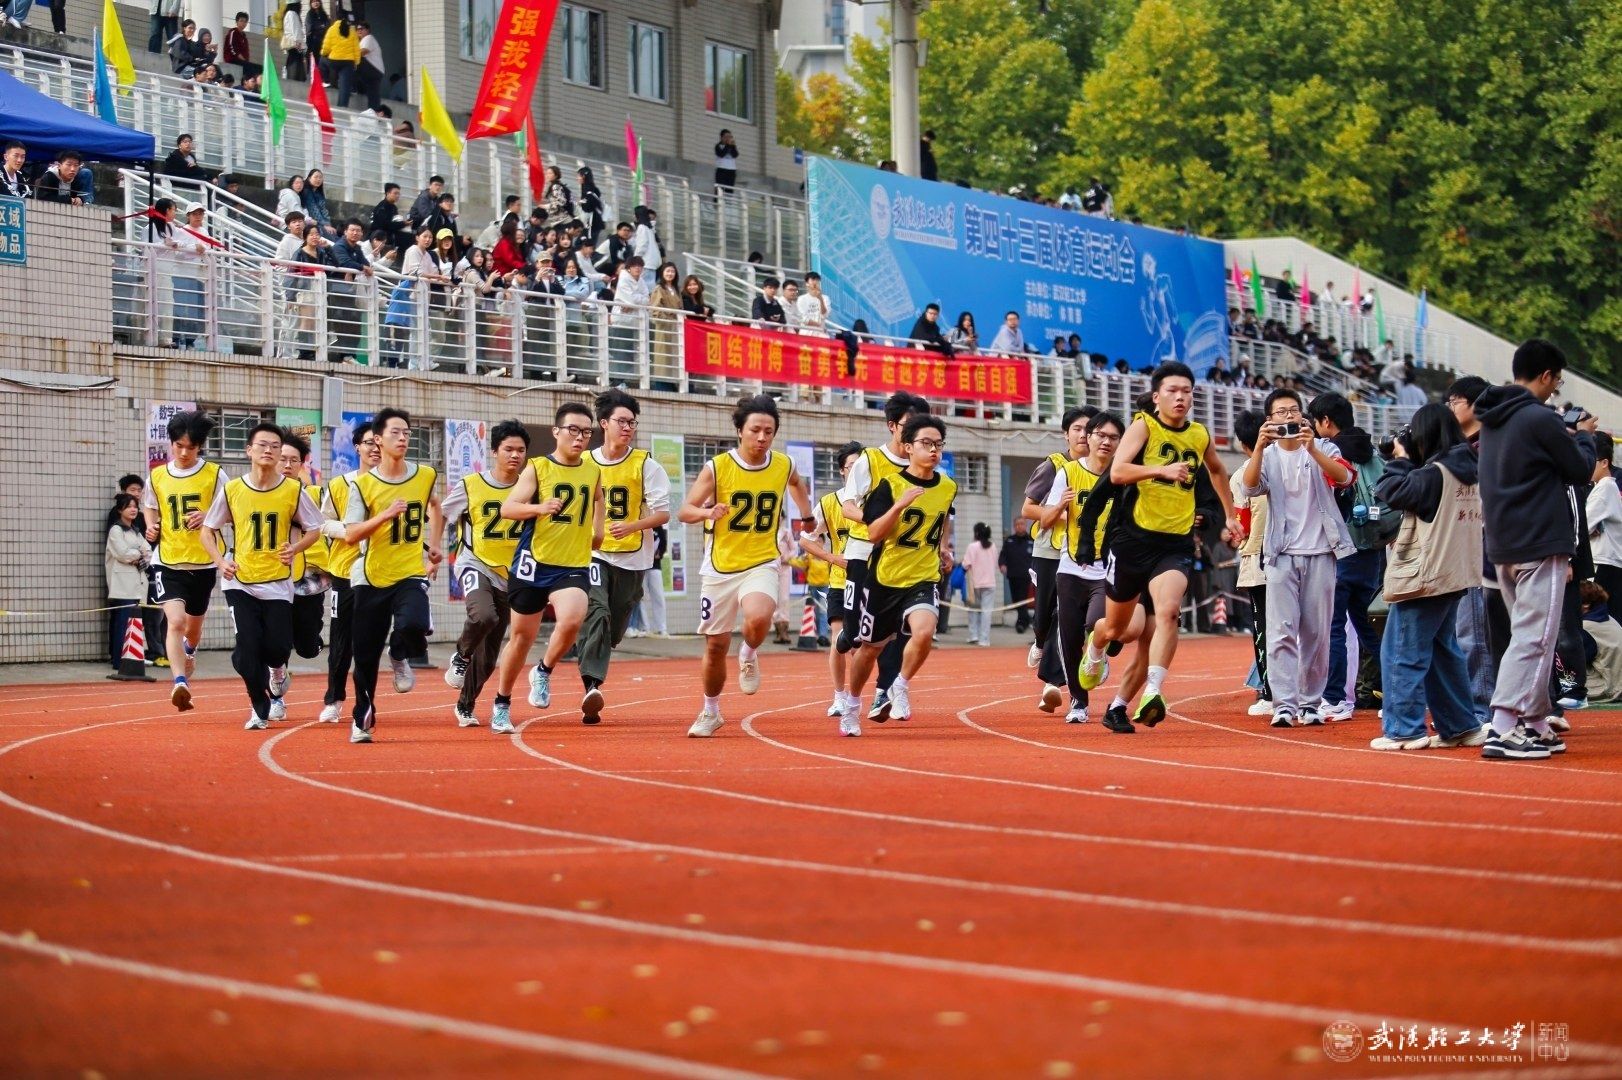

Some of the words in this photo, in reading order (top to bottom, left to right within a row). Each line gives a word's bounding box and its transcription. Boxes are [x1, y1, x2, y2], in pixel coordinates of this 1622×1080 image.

[478, 5, 541, 132] 强我轻工
[964, 202, 1136, 285] 第四十三届体育运动会
[706, 331, 784, 373] 团结拼搏
[958, 361, 1018, 396] 自信自强
[150, 423, 170, 440] 计算
[166, 492, 202, 532] 15
[389, 499, 423, 546] 18
[551, 482, 591, 527] 21
[728, 489, 779, 534] 28
[250, 511, 279, 552] 11
[895, 506, 947, 552] 24
[464, 573, 476, 592] 9
[519, 553, 533, 577] 5
[861, 614, 872, 637] 6
